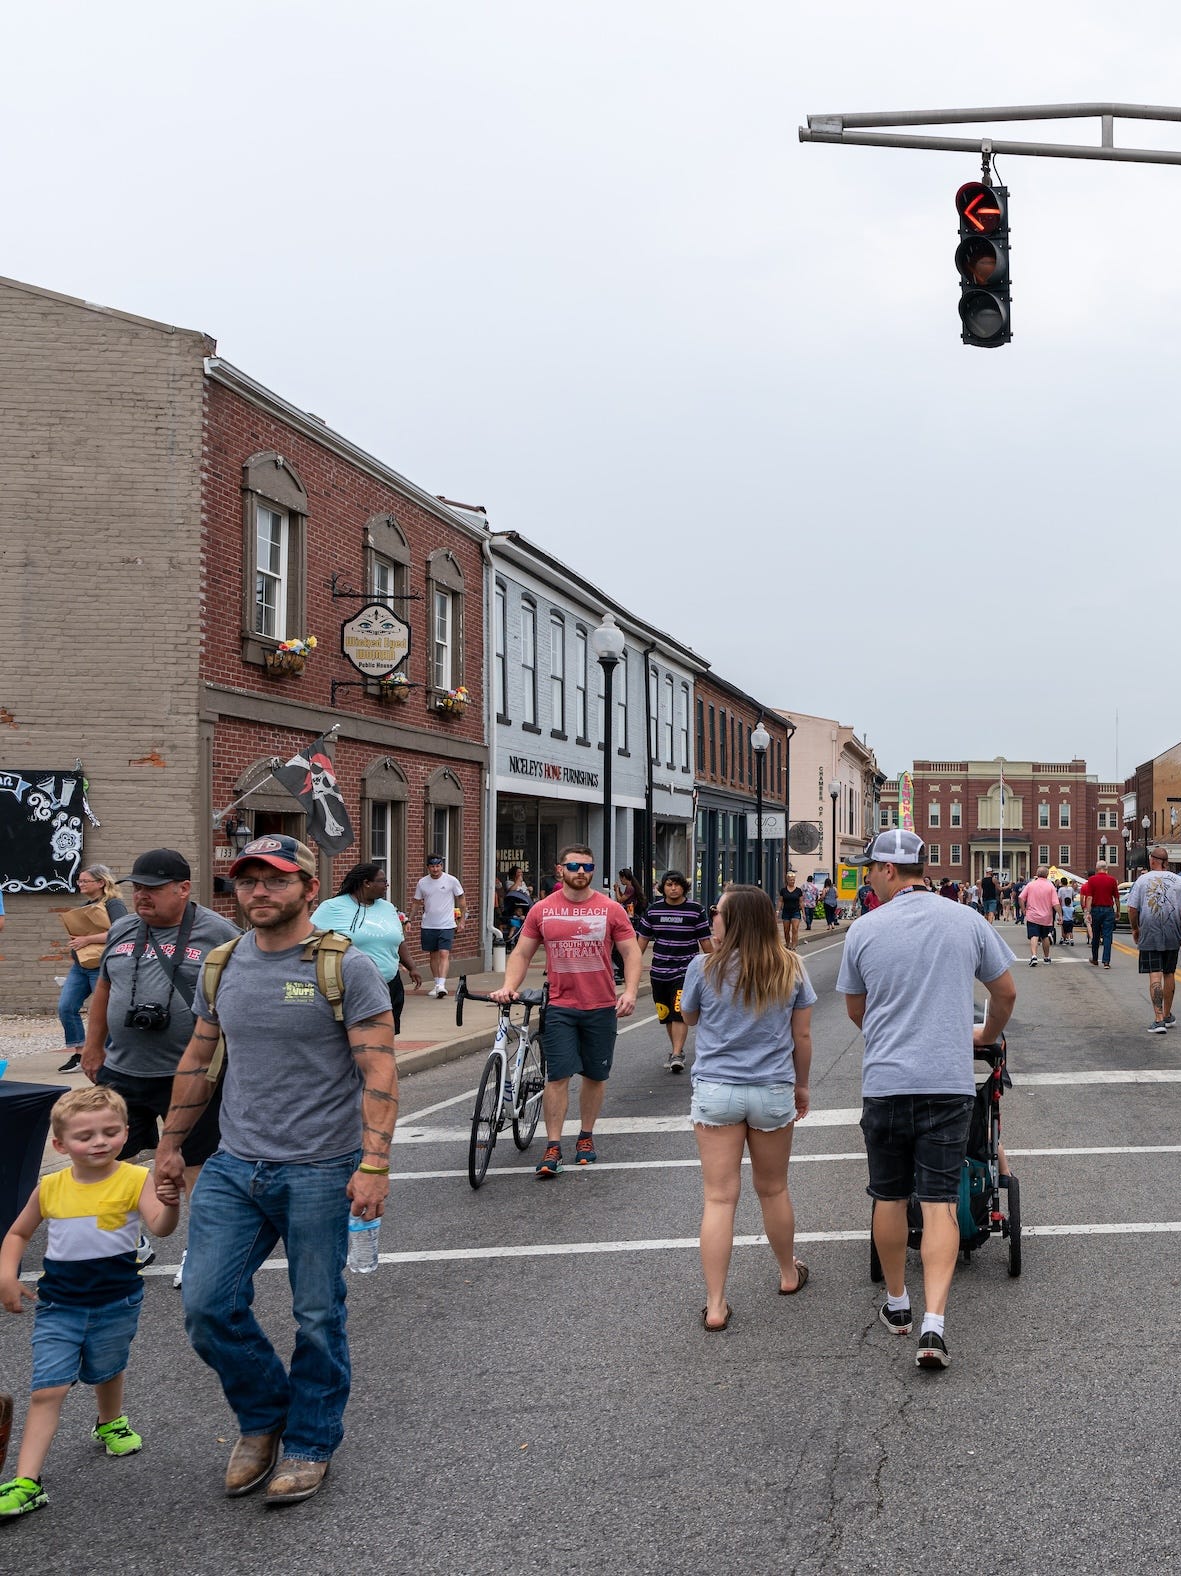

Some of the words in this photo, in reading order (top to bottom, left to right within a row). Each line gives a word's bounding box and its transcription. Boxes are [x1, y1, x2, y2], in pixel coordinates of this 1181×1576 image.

[509, 755, 543, 778] NICELEY'S
[544, 763, 562, 781] HOME
[562, 767, 599, 788] FURNISHINGS
[220, 848, 232, 858] 133
[542, 908, 569, 916] PALM
[573, 908, 609, 916] BEACH
